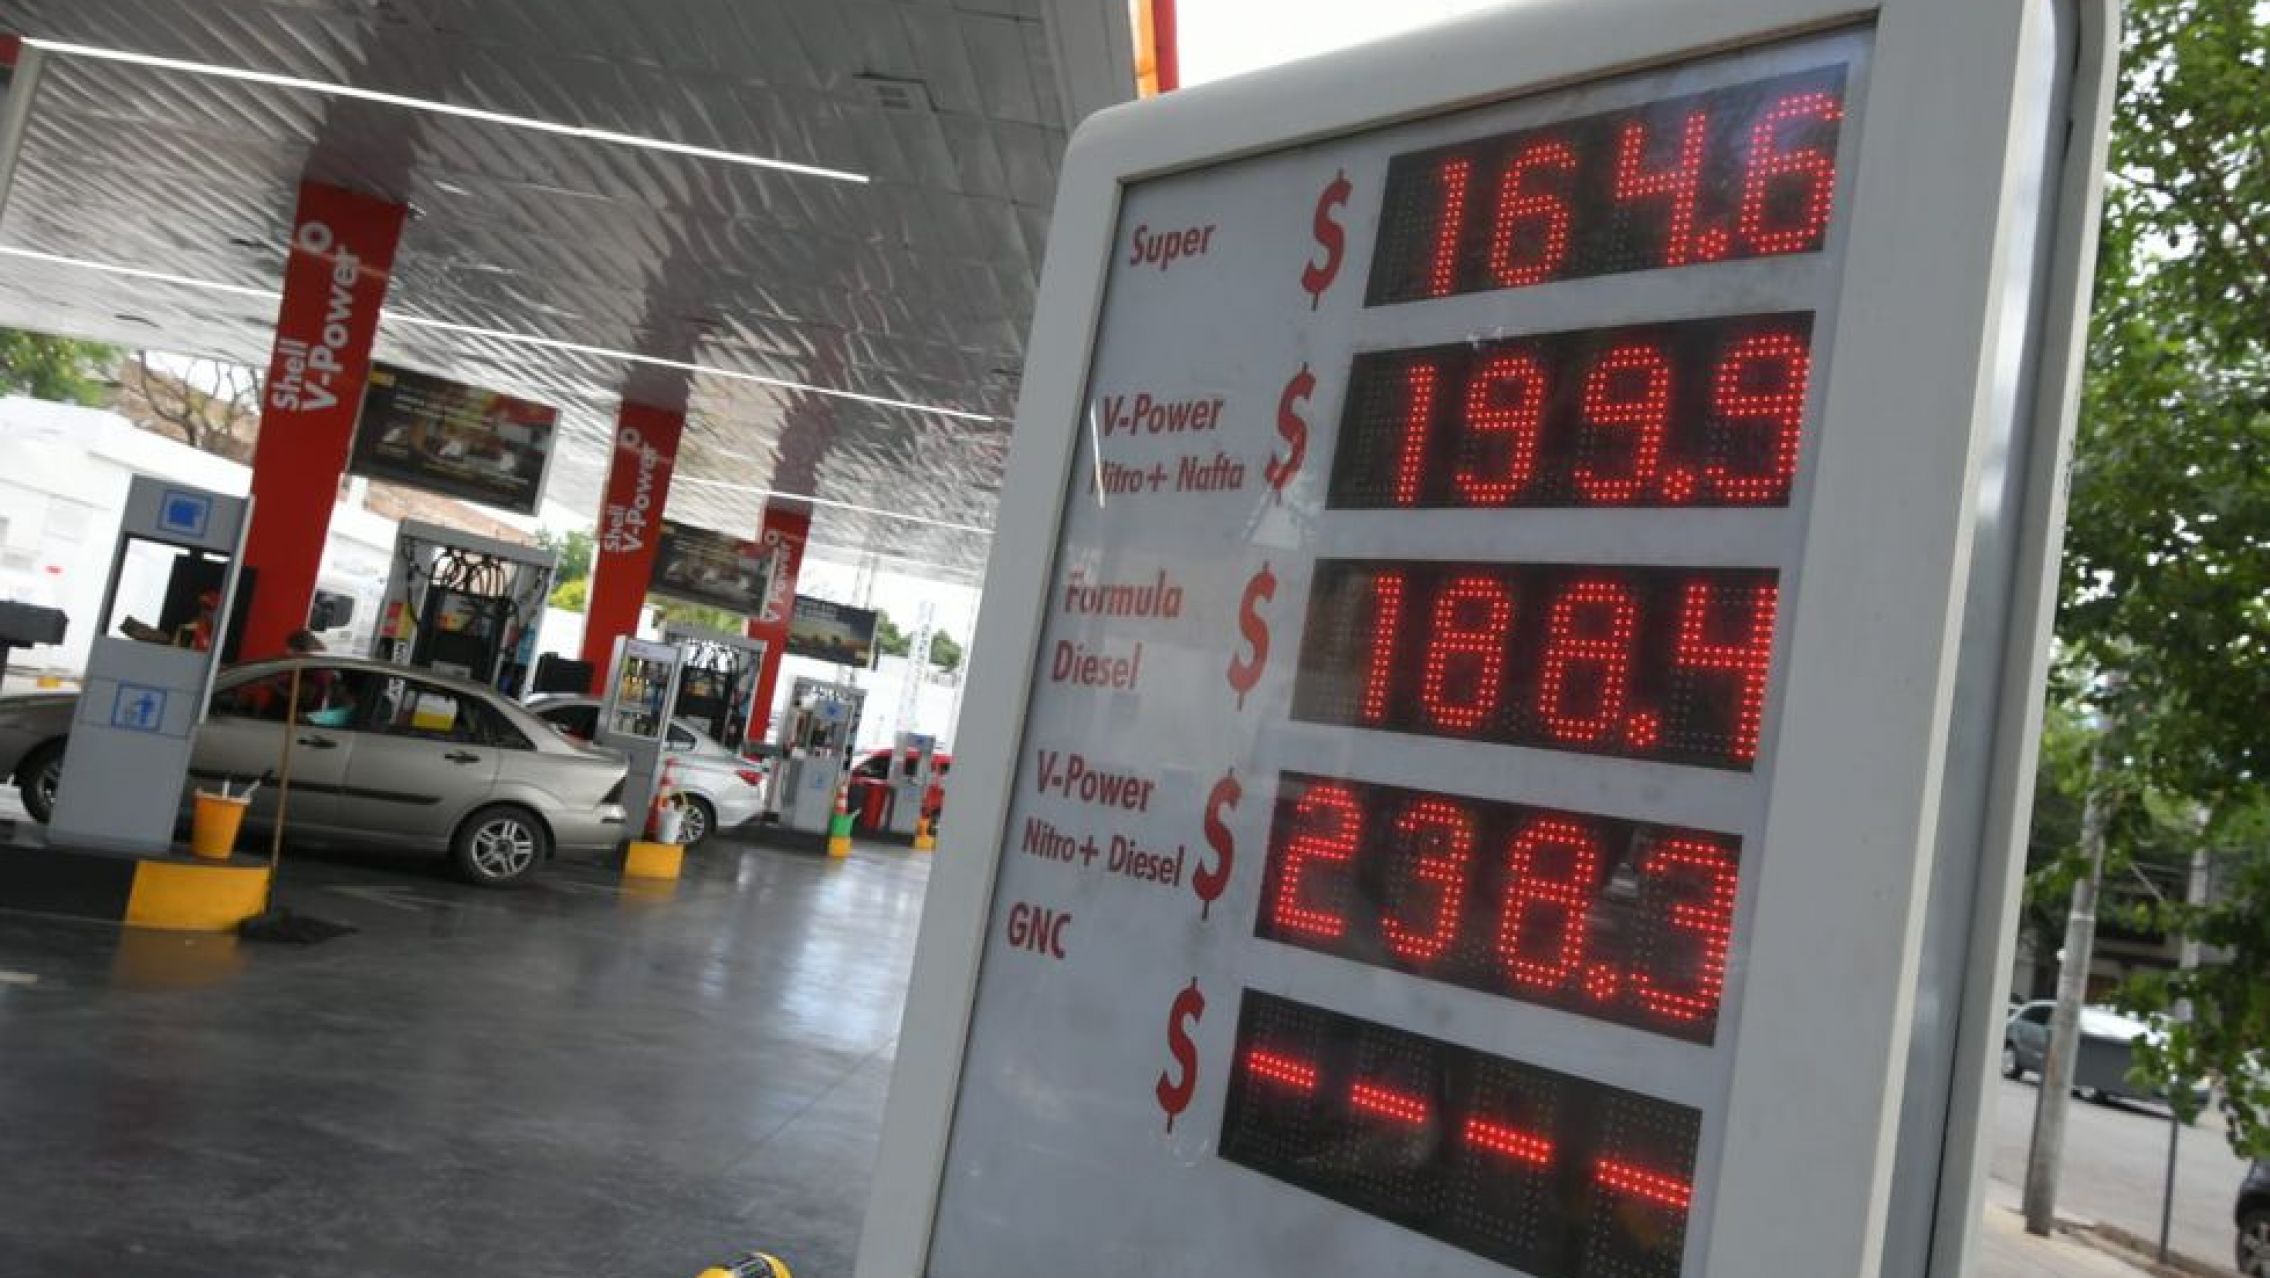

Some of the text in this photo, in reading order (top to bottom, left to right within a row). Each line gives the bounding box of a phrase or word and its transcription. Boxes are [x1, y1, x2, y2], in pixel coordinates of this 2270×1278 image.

[1301, 92, 1844, 311] $ 164.6
[1129, 225, 1216, 270] Super
[301, 245, 360, 411] V-Power
[271, 338, 309, 411] Shell
[1103, 391, 1224, 437] V-Power
[1264, 333, 1812, 504] $ 199.9
[1176, 451, 1245, 492] Nafta
[1064, 568, 1184, 619] Formula
[1051, 640, 1143, 690] Diesel
[1227, 560, 1780, 760] $ 188.4
[1037, 750, 1155, 811] V-Power
[1107, 834, 1185, 888] Diesel
[1192, 767, 1740, 1021] $ 238.3
[1007, 903, 1072, 960] GNC
[1155, 976, 1206, 1134] $
